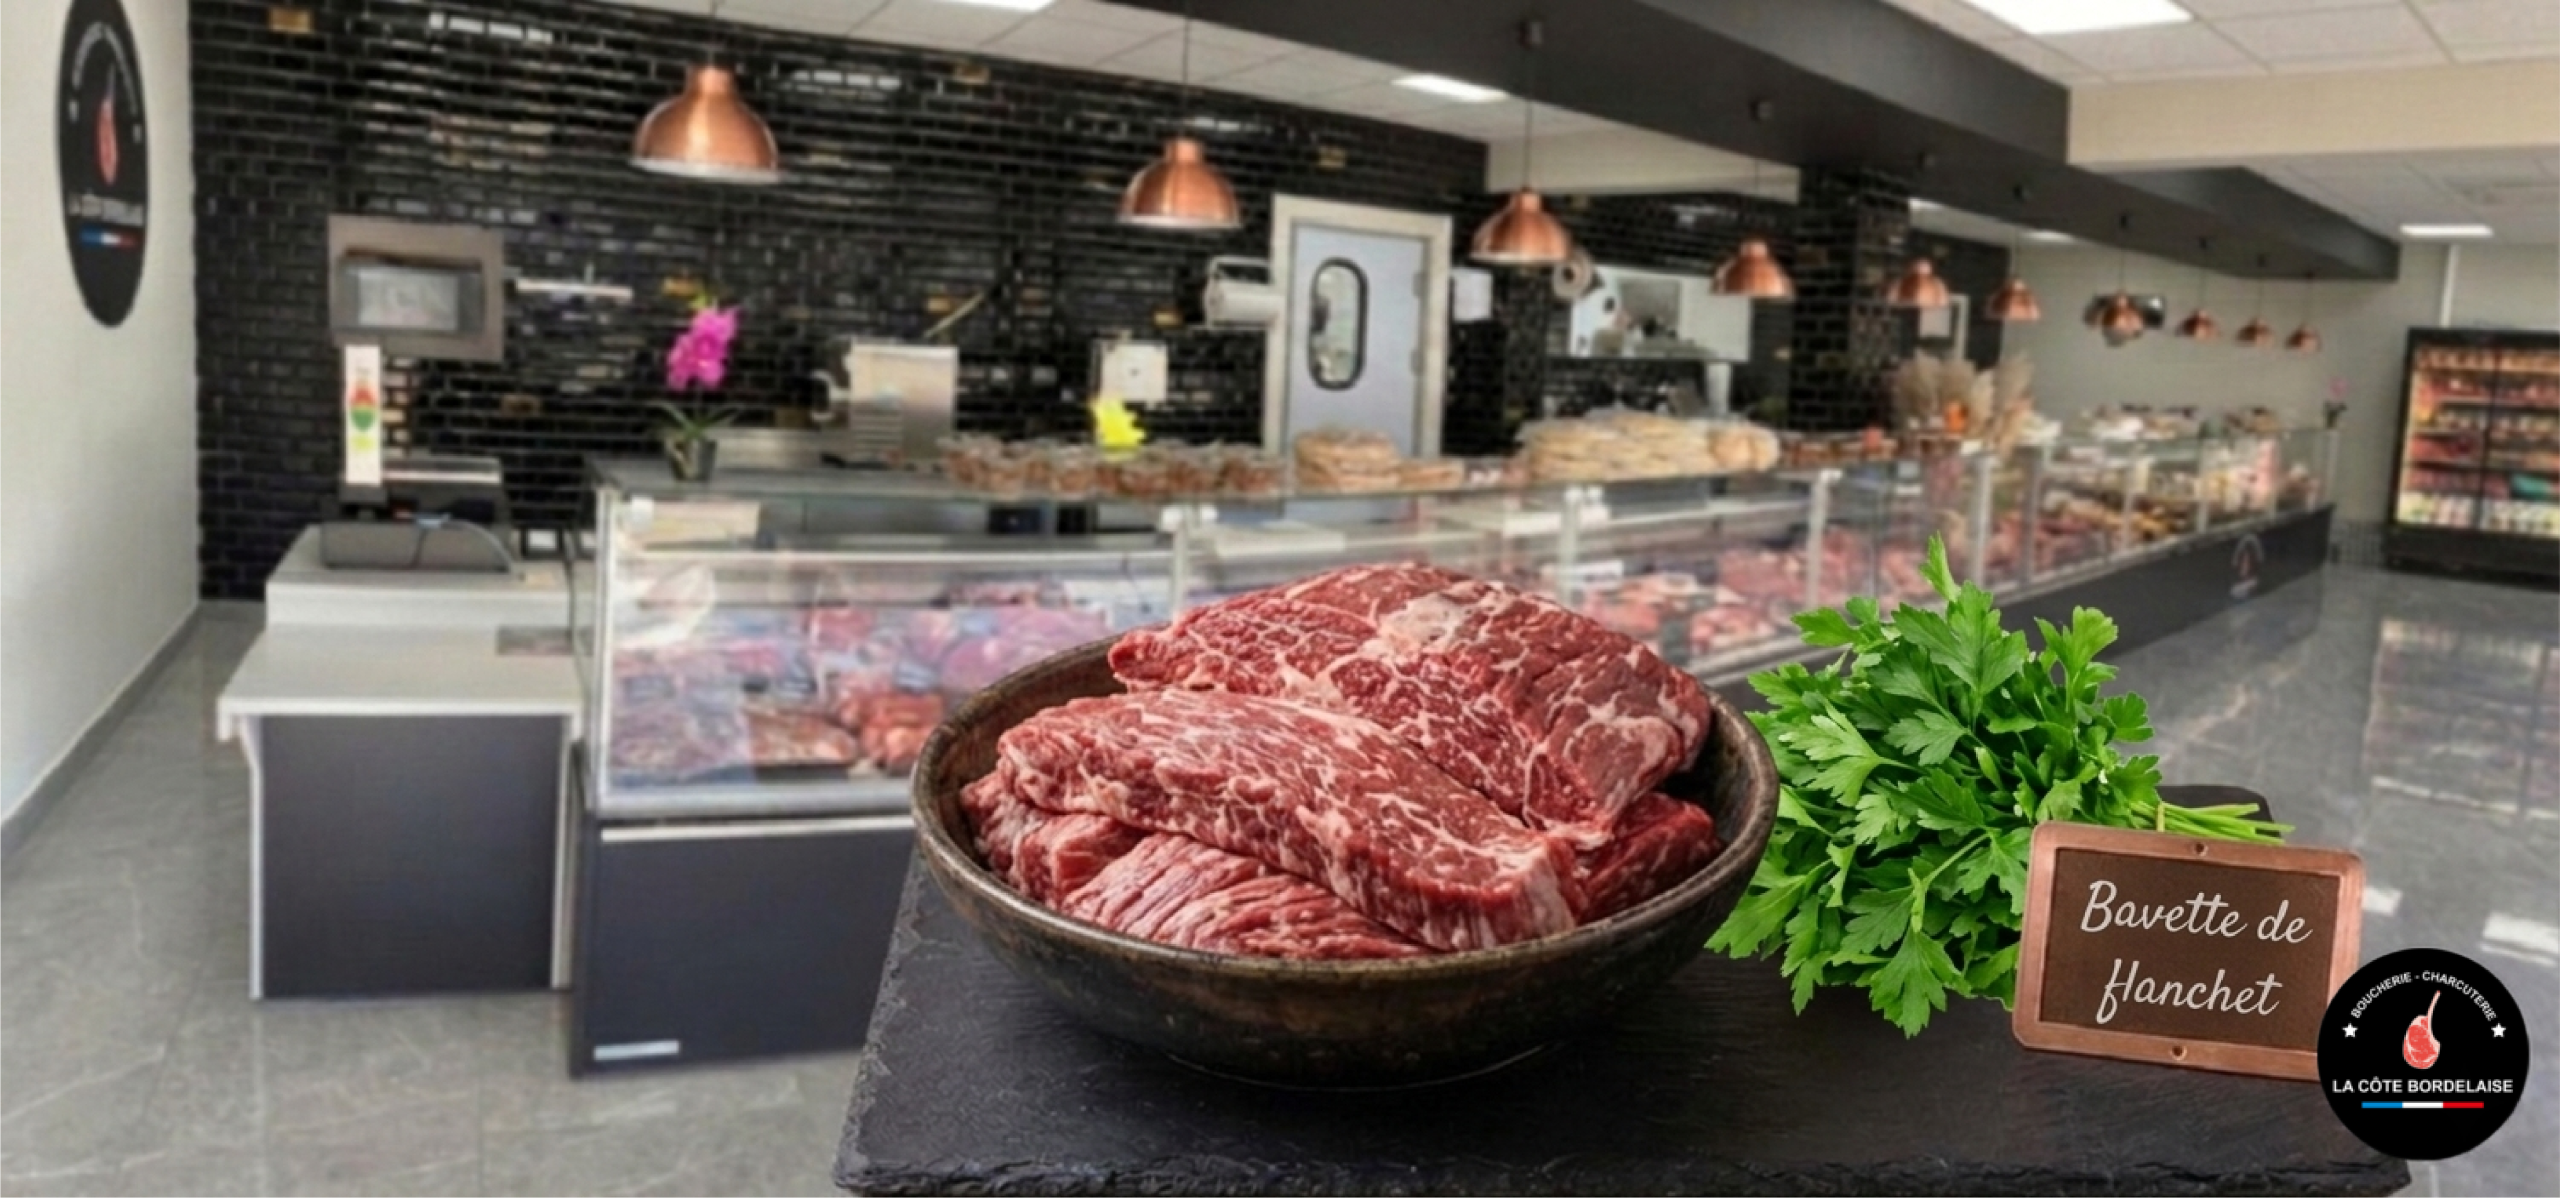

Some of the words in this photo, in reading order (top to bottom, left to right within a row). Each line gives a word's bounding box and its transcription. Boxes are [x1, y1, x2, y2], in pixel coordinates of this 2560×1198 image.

[2080, 880, 2248, 937] Bavette
[2257, 899, 2313, 943] de
[2096, 958, 2283, 1025] flanchet
